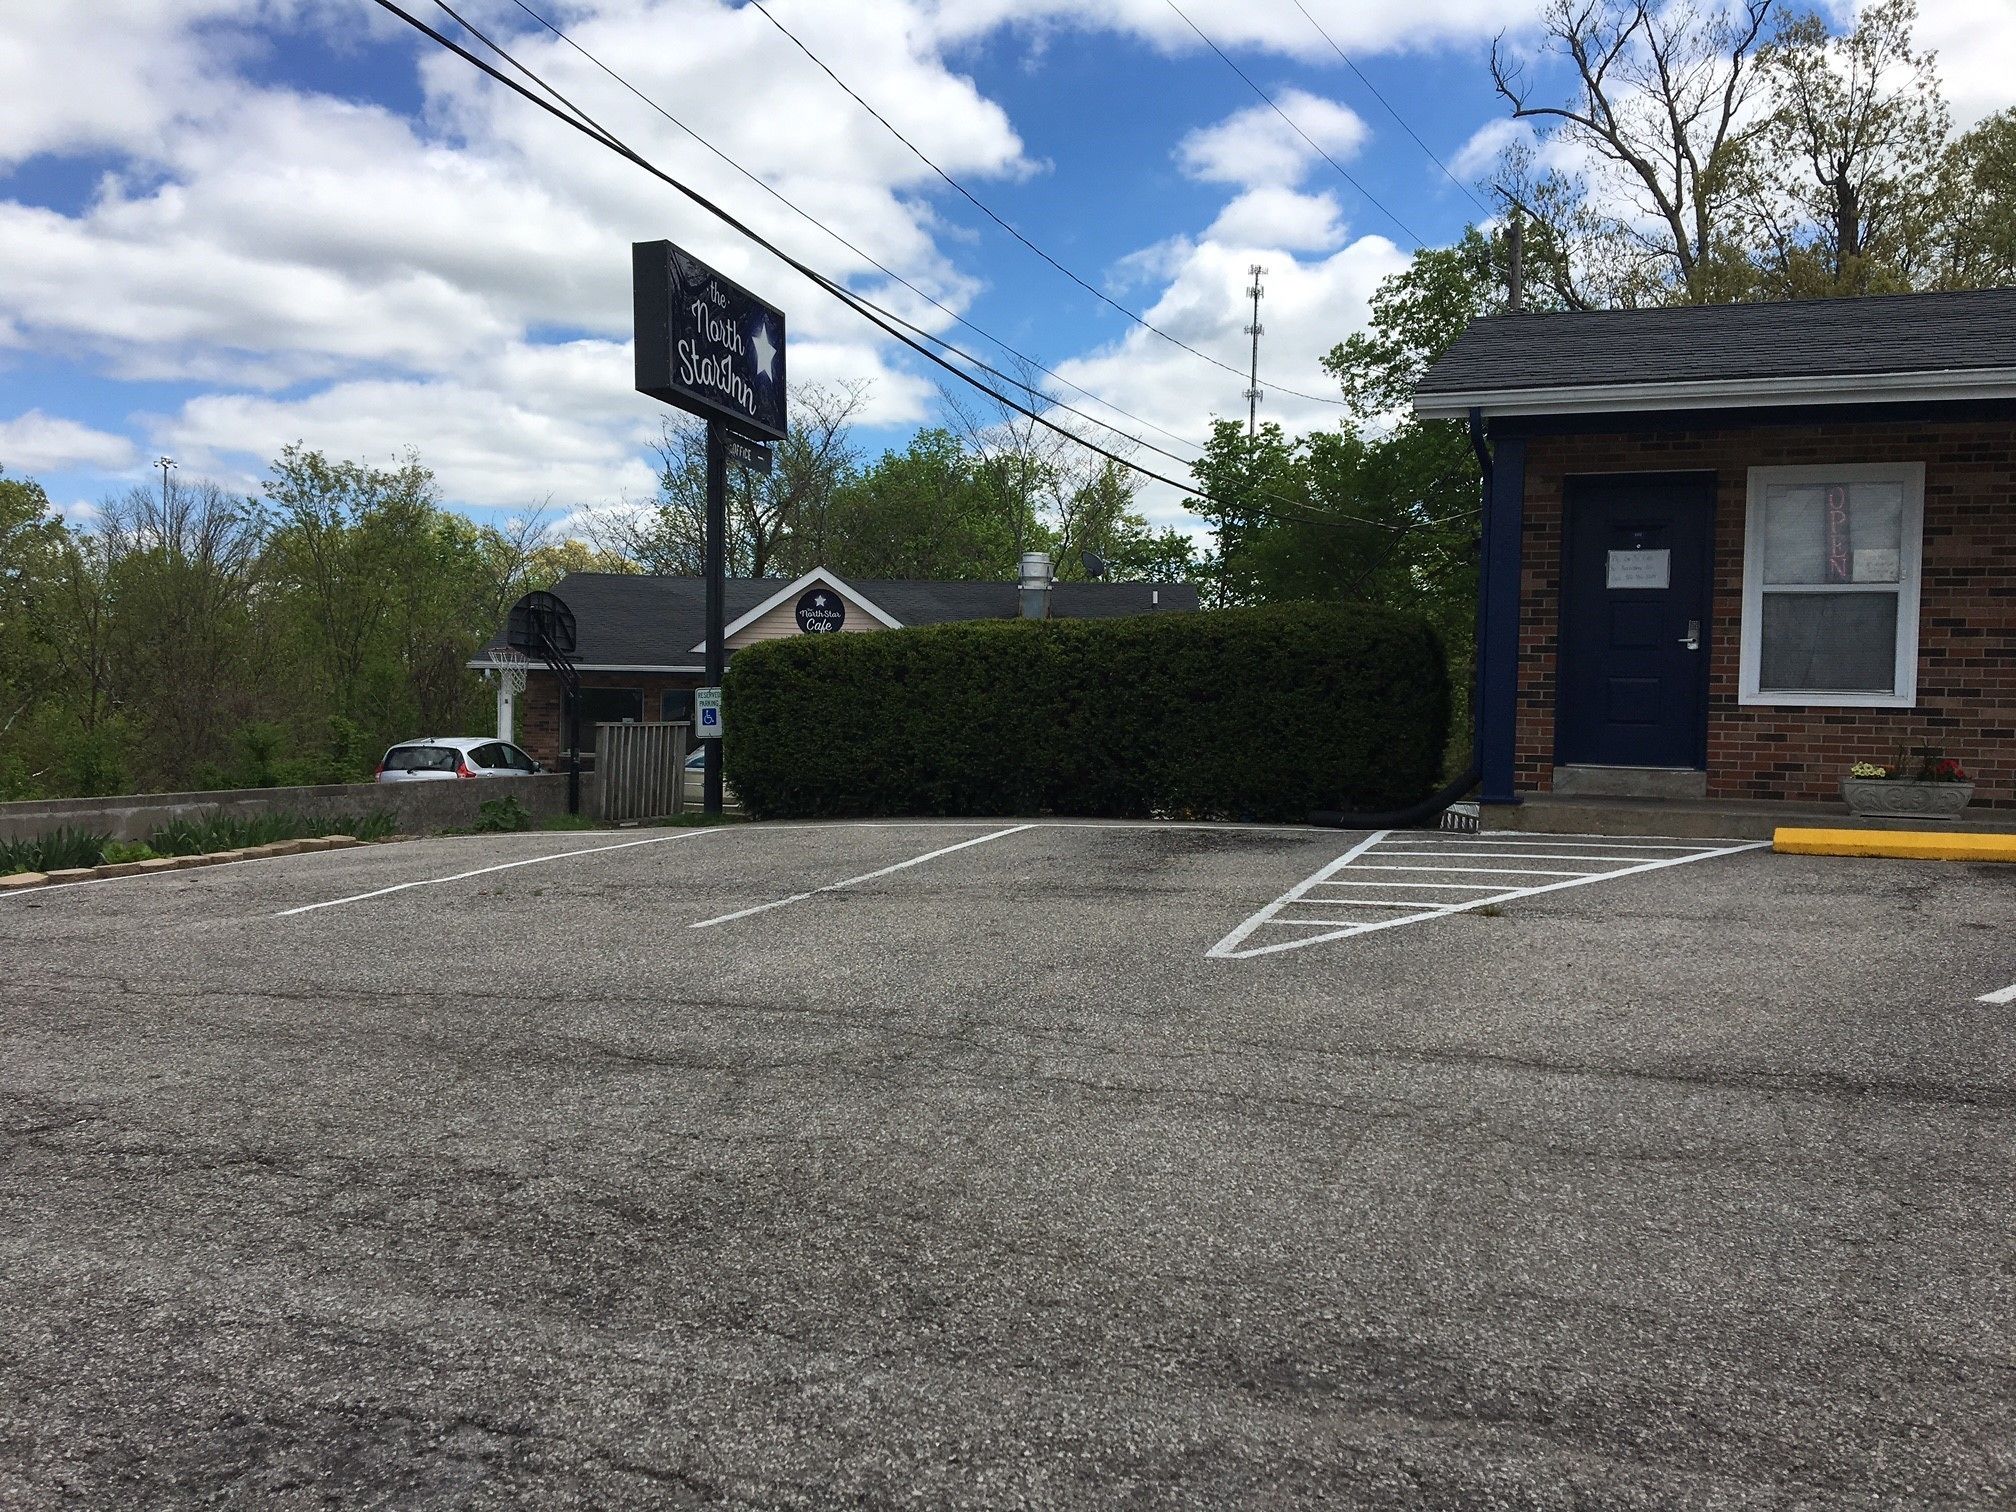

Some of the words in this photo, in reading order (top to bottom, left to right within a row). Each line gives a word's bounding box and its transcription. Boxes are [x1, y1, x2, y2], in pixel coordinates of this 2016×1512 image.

[710, 281, 727, 309] the
[691, 300, 745, 356] North
[1828, 486, 1847, 578] OPEN
[799, 609, 824, 618] North
[824, 609, 842, 618] Star
[806, 618, 833, 633] Cafe
